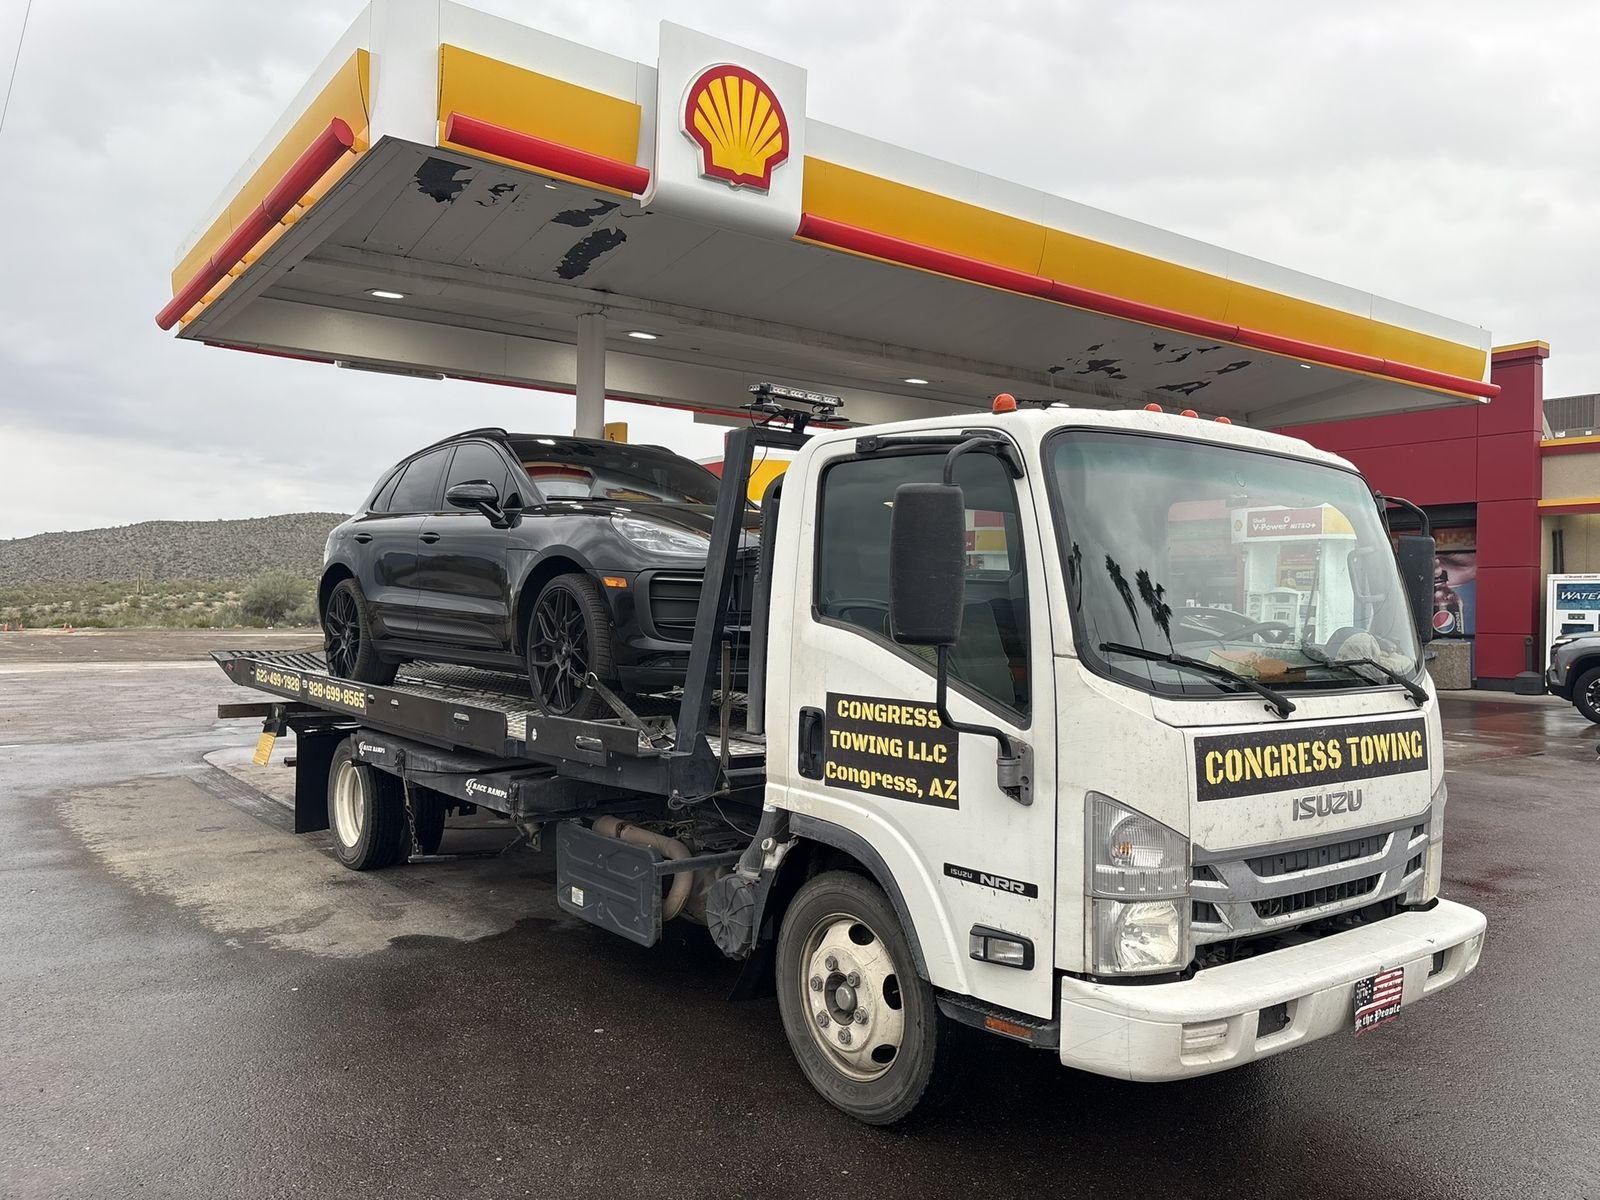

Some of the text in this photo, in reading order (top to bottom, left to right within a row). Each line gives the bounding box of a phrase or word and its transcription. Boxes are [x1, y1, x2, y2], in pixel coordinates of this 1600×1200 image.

[1253, 523, 1287, 531] V-Power
[837, 700, 942, 729] CONGRESS
[830, 730, 947, 764] TOWING LLC
[1205, 730, 1423, 785] CONGRESS TOWING
[825, 761, 958, 800] Congress, AZ
[1293, 789, 1363, 821] ISUZU
[950, 867, 1025, 895] ISUZU NRR
[1362, 1013, 1375, 1026] the
